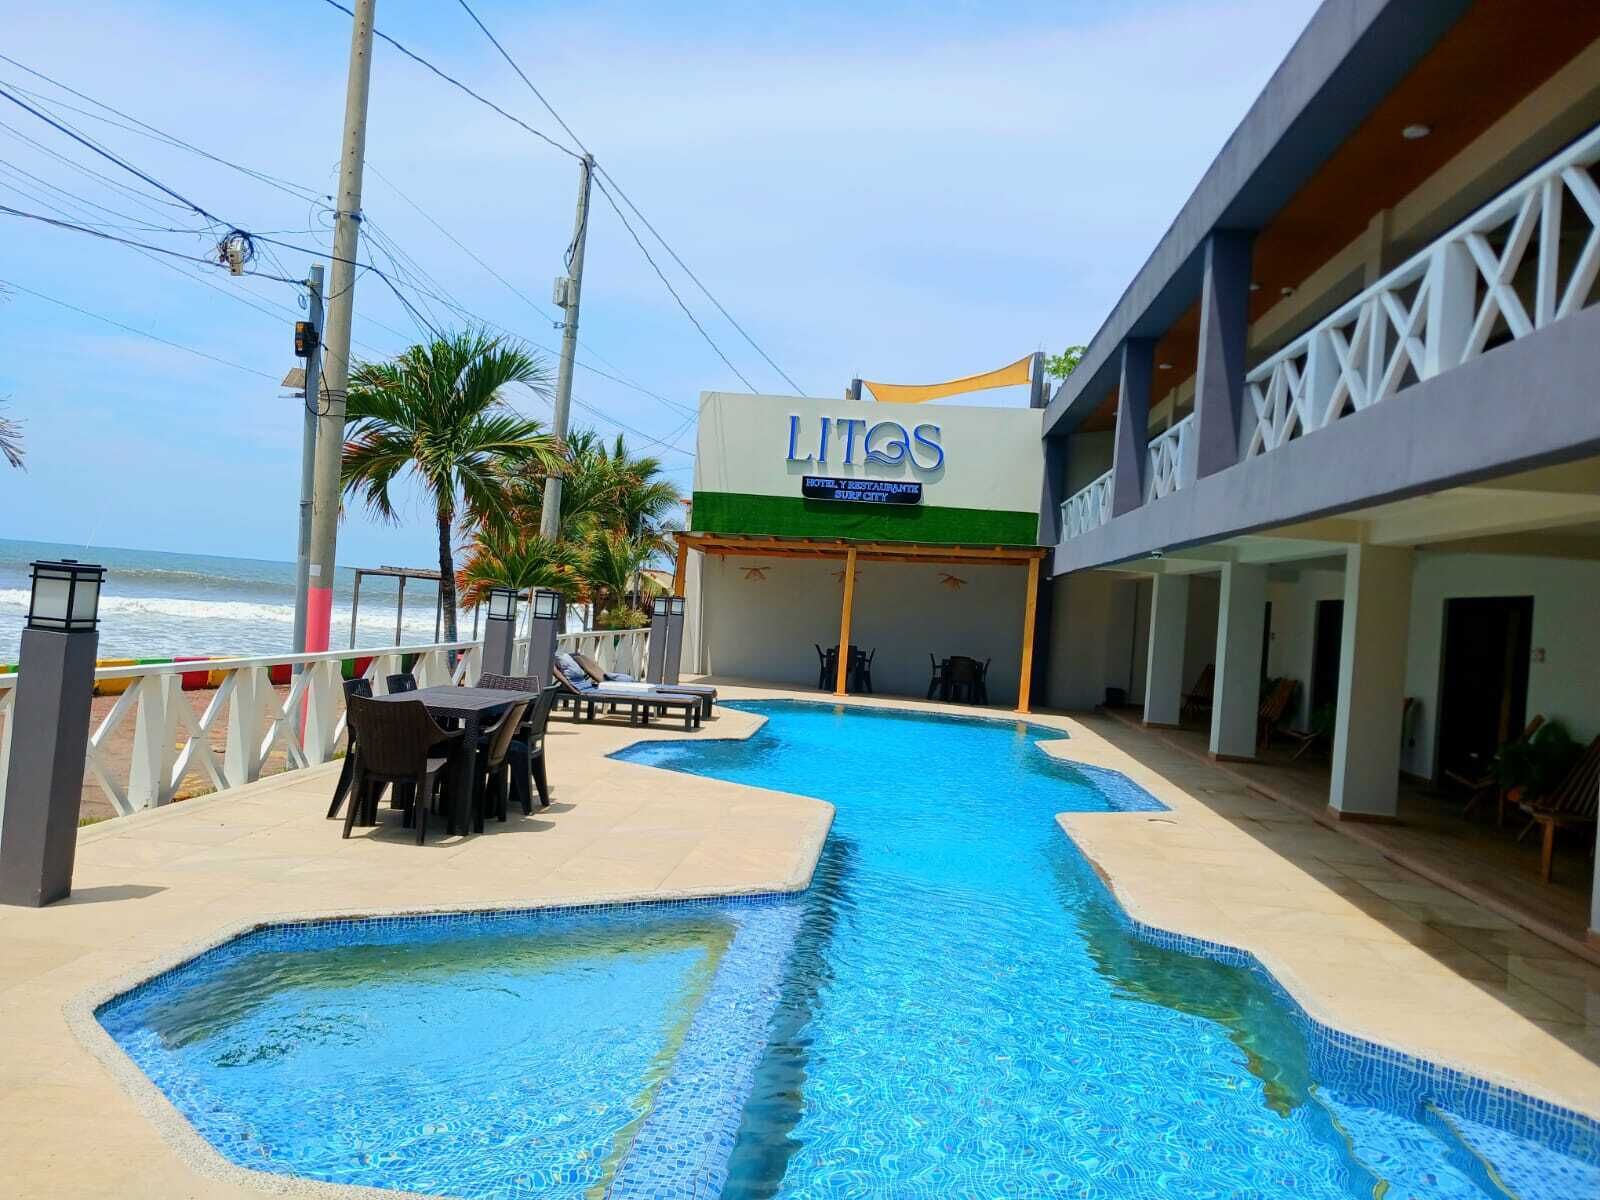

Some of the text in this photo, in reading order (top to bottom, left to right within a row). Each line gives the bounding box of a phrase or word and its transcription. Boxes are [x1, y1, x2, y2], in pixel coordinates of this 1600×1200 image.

[785, 415, 944, 472] LITOS
[806, 478, 919, 494] HOTEL Y RESTAURANTE
[834, 490, 889, 502] SURF CITY
